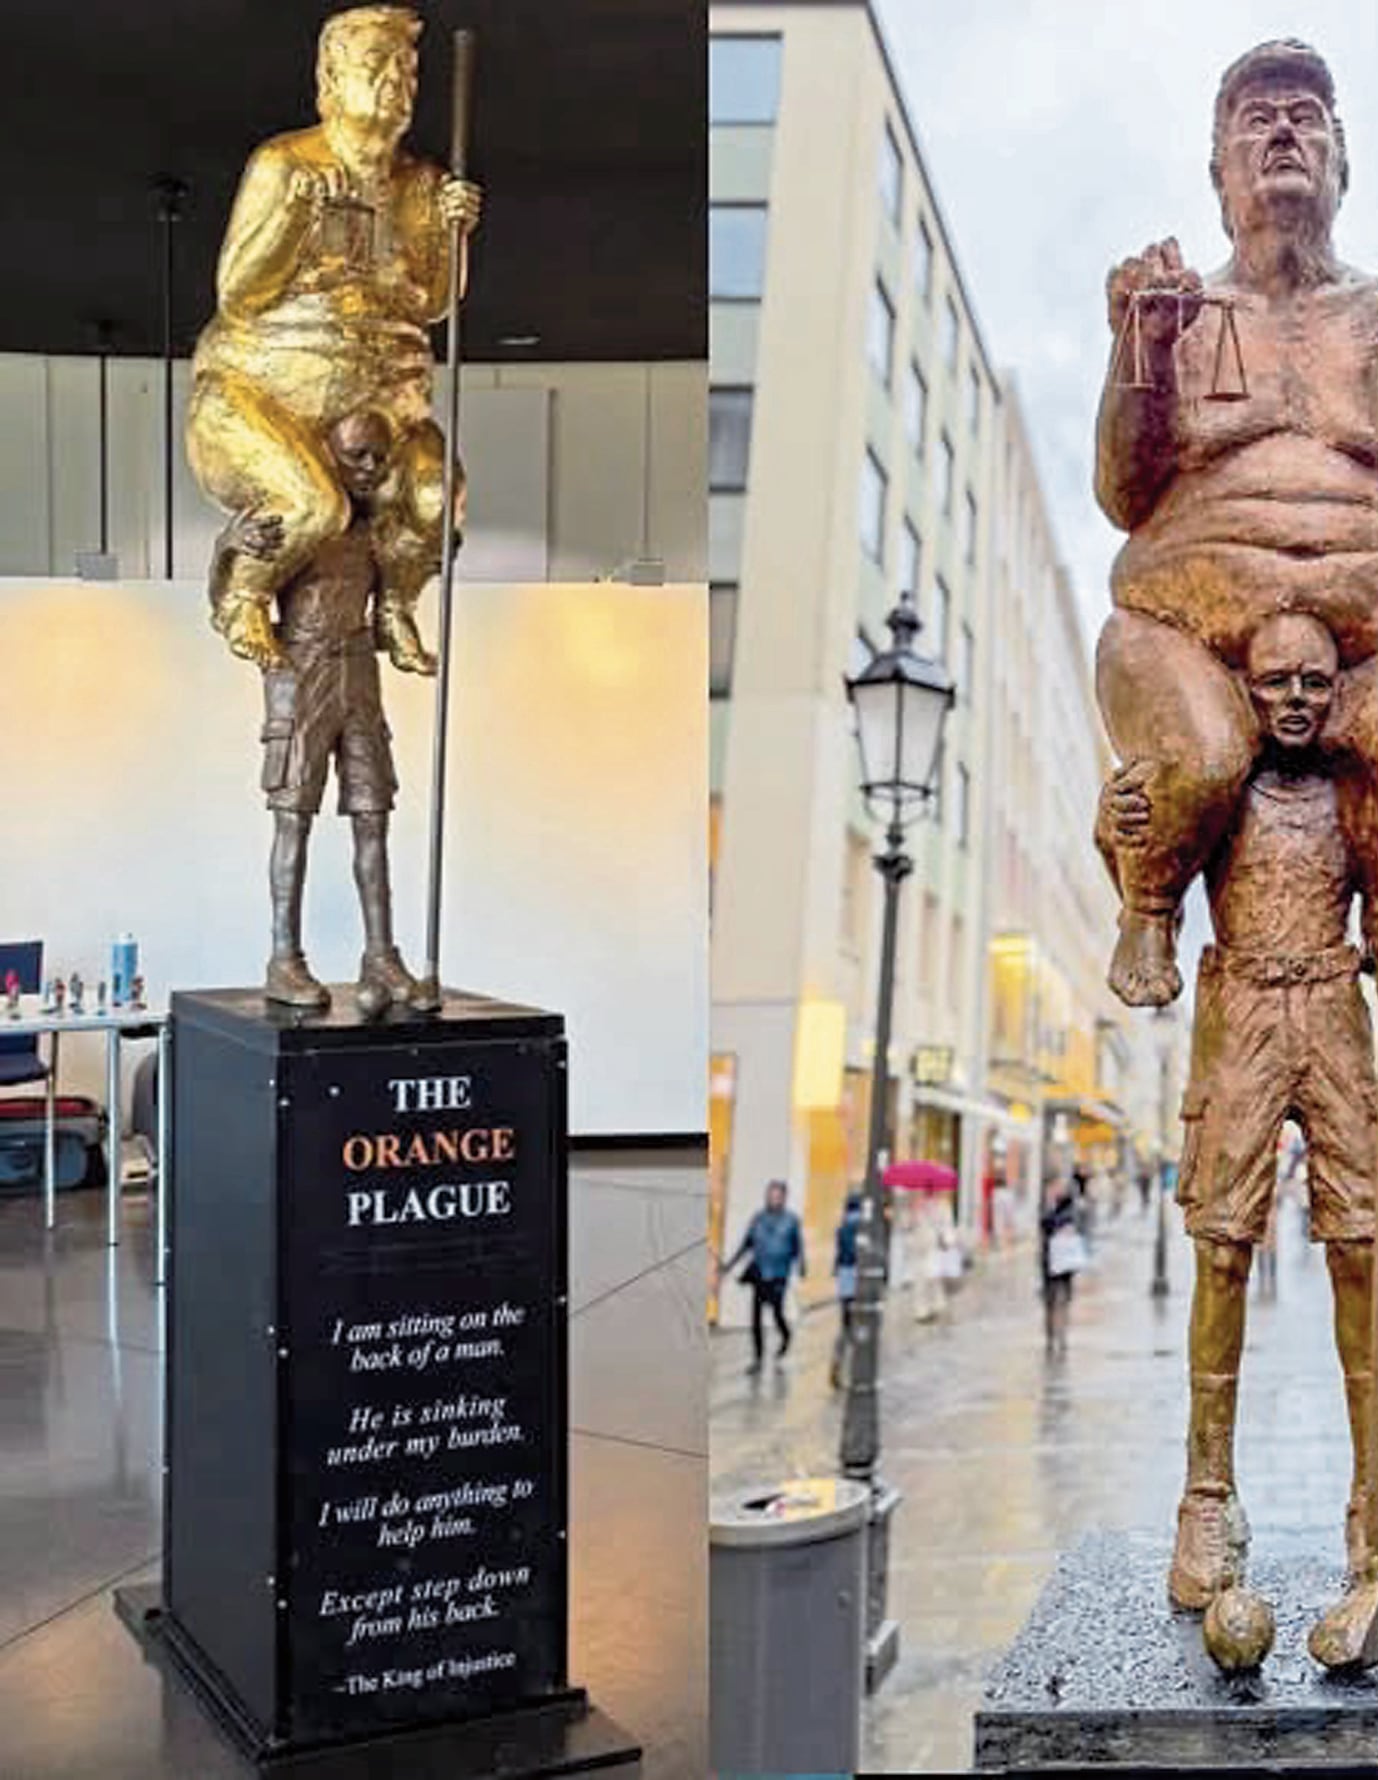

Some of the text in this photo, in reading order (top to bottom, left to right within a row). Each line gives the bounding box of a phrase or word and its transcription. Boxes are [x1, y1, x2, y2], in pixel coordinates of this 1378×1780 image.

[388, 1076, 471, 1112] THE
[343, 1126, 514, 1171] ORANGE
[348, 1182, 511, 1226] PLAGUE
[331, 1302, 526, 1345] I am sitting on the
[351, 1339, 504, 1371] back of a man.
[350, 1395, 507, 1432] He is sinking
[327, 1421, 524, 1465] under my burden.
[319, 1479, 533, 1527] I will do anything to
[377, 1516, 475, 1548] help him.
[319, 1566, 531, 1616] Except step down
[346, 1595, 500, 1646] from his back.
[382, 1668, 424, 1690] King
[426, 1661, 445, 1681] of
[449, 1652, 517, 1679] Injustice
